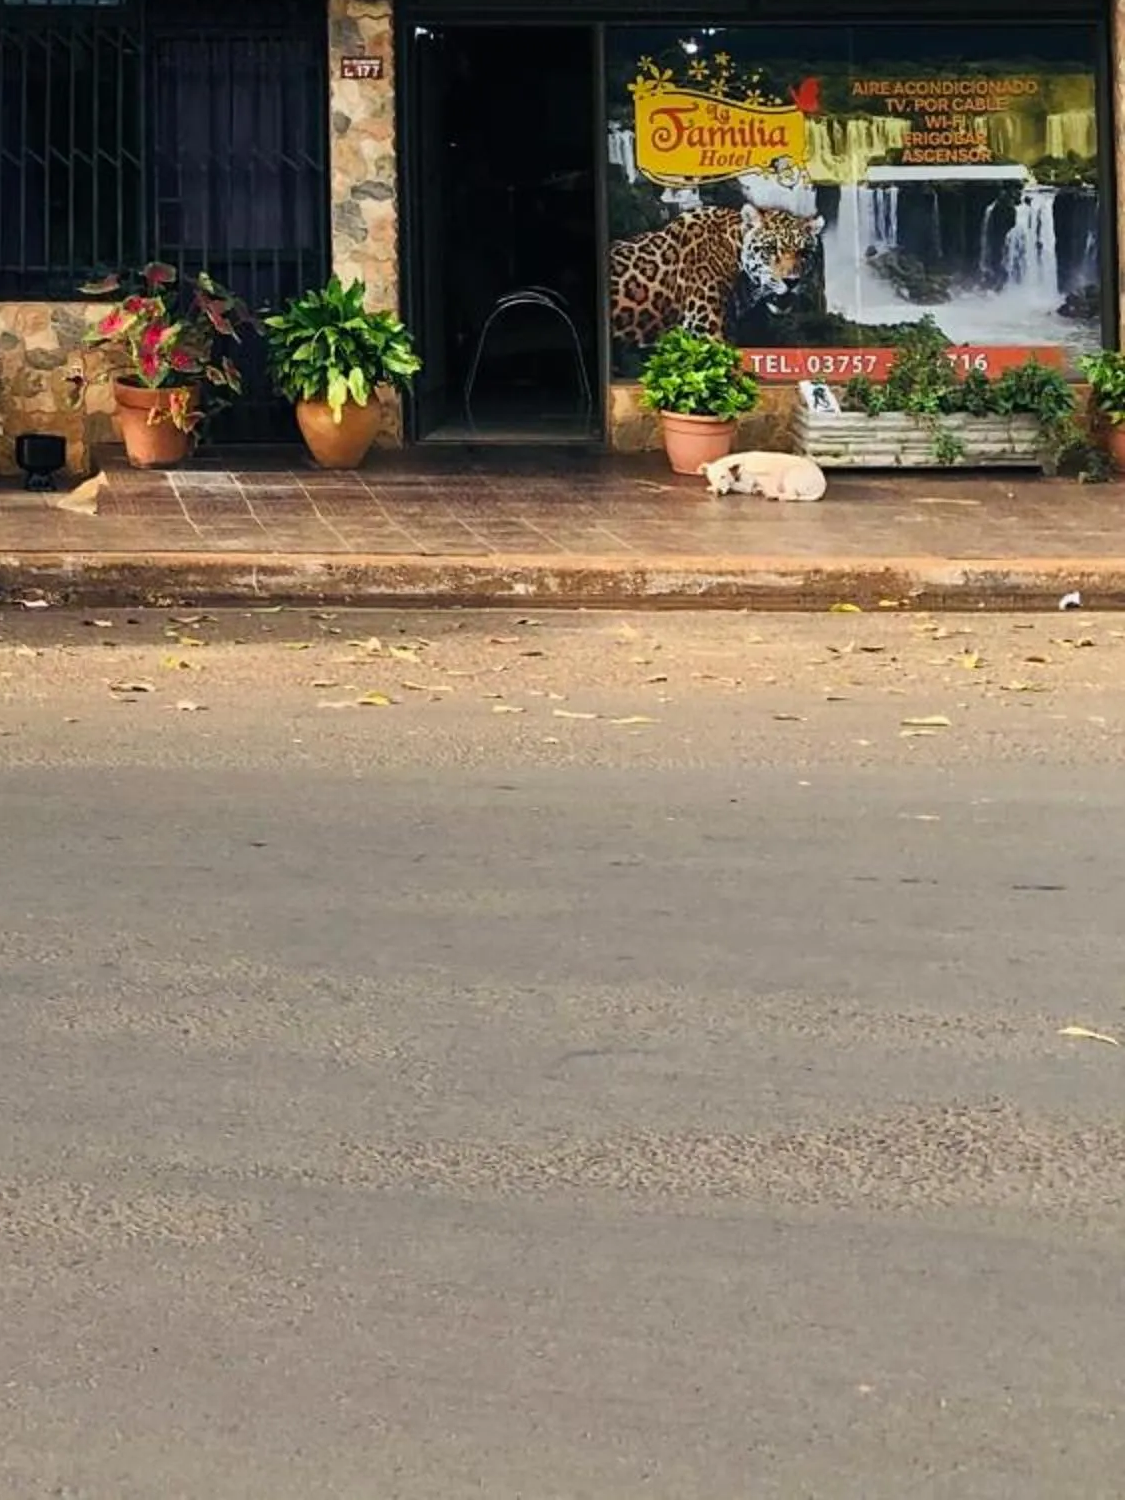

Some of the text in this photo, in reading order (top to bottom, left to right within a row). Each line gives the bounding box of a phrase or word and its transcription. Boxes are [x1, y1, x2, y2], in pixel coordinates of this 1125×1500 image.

[852, 80, 1038, 96] AIRE ACONDICIONADO
[914, 98, 950, 112] POR
[952, 97, 1007, 111] CABLE
[706, 104, 732, 125] La
[925, 114, 966, 129] WI-FI
[649, 102, 789, 152] Familia
[699, 150, 752, 167] Hotel
[902, 148, 991, 164] ASCENSOR
[751, 355, 800, 373] TEL.
[807, 355, 877, 373] 03757
